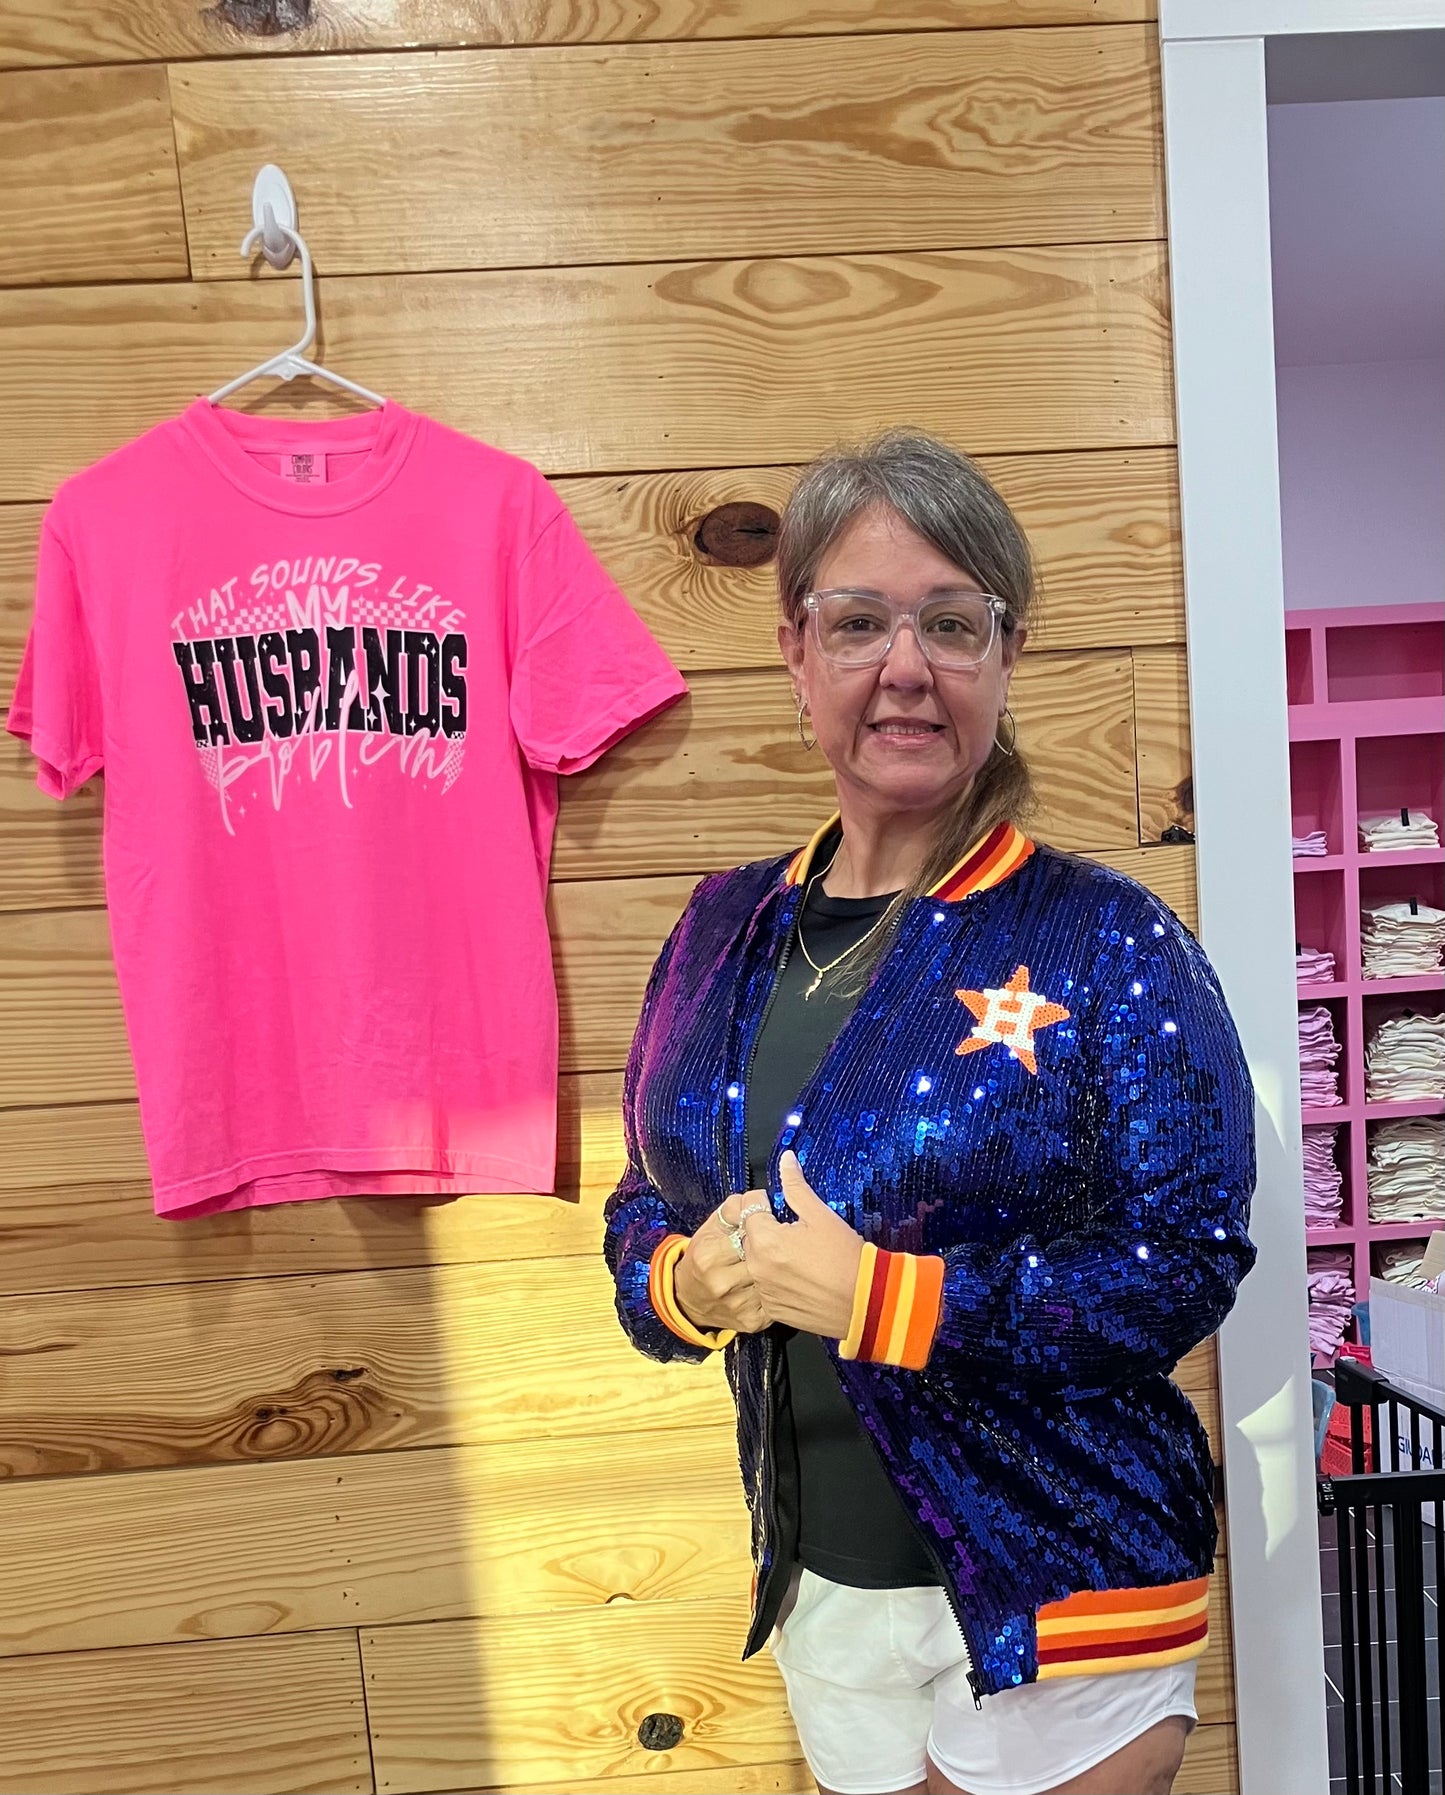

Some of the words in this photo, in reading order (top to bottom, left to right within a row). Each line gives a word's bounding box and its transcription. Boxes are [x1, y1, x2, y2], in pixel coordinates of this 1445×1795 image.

[170, 577, 239, 646] THAT
[250, 556, 383, 598] SOUNDS
[388, 576, 466, 632] LIKE
[285, 583, 350, 634] MY
[172, 626, 468, 748] HUSBANDS
[971, 988, 1046, 1052] H
